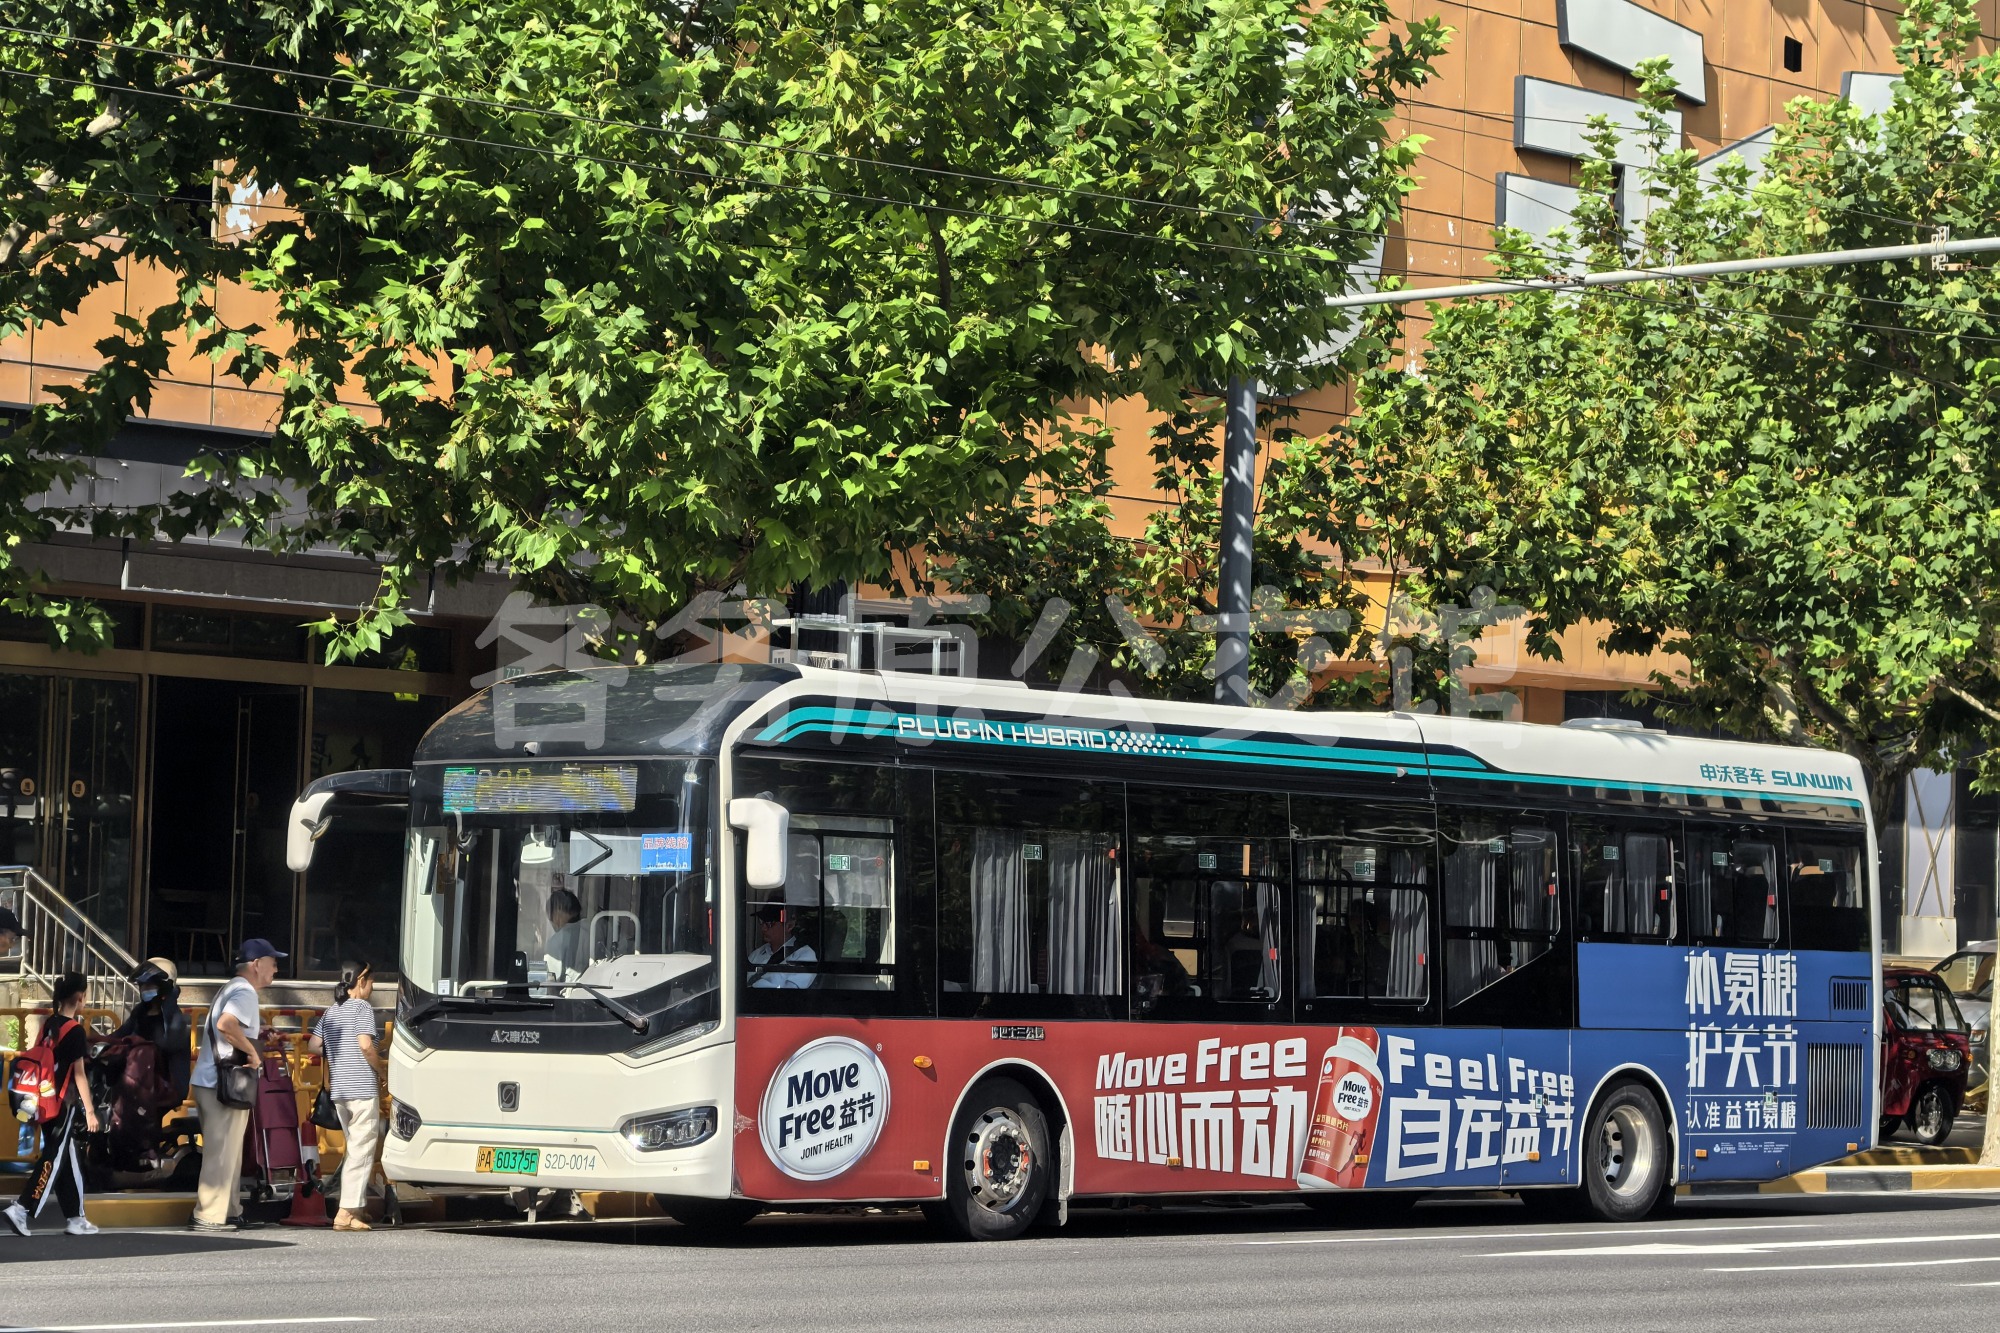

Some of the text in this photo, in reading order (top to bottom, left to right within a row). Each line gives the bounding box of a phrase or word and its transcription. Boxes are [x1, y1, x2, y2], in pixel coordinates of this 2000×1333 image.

[897, 716, 1107, 749] PLUG-IN HYBRID
[1699, 763, 1853, 792] 申沃客车 SUNWIN
[1684, 949, 1798, 1017] 补氨糖
[1095, 1037, 1307, 1090] Move Free
[1386, 1034, 1575, 1098] Feel Free
[1685, 1021, 1799, 1088] 护关节
[786, 1062, 859, 1109] Move
[1337, 1092, 1358, 1104] Free
[1342, 1080, 1367, 1095] Move
[778, 1091, 876, 1149] Free 益节
[1094, 1085, 1308, 1180] 随心而动
[1385, 1088, 1575, 1182] 自在益节
[496, 1150, 538, 1171] 60375F
[544, 1153, 596, 1170] S2D-0014
[800, 1133, 853, 1160] JOINT HEALTH
